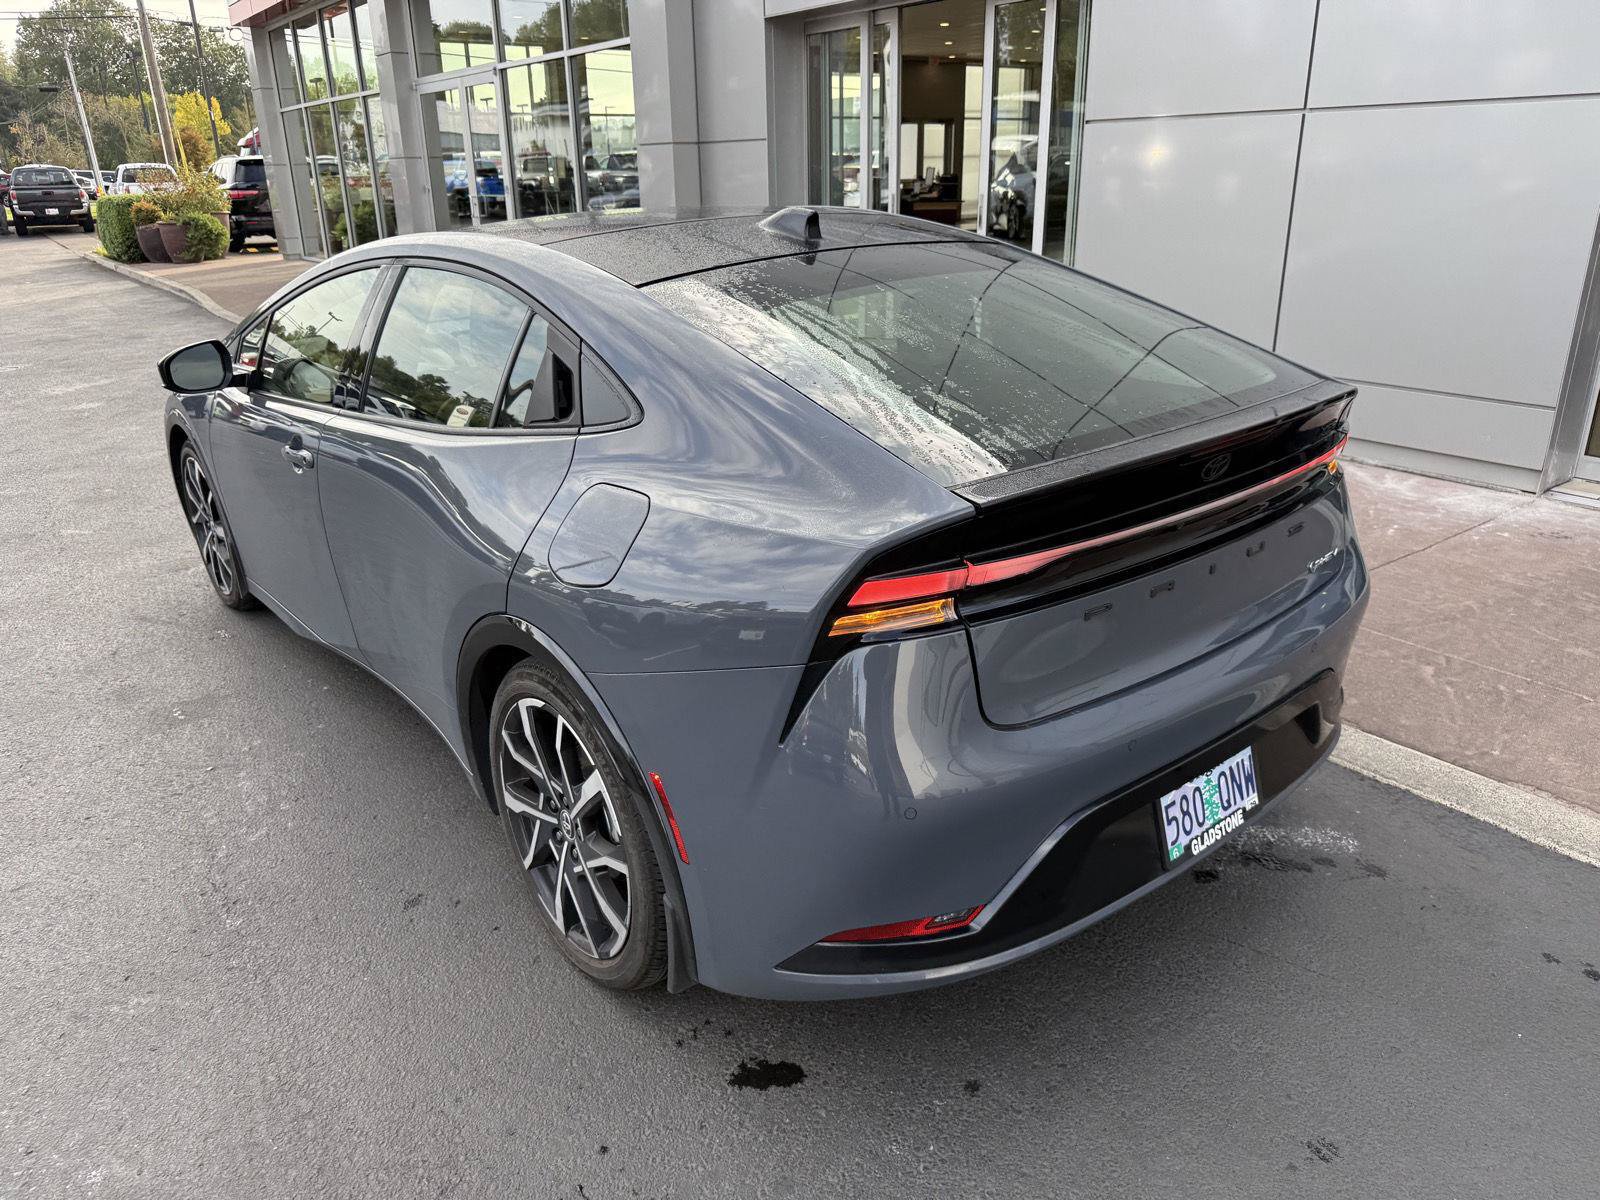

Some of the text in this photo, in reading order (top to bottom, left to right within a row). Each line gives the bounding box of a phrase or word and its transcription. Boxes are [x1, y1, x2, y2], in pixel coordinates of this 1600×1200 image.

[1164, 754, 1256, 847] 580 QNW
[1191, 808, 1245, 855] GLADSTONE
